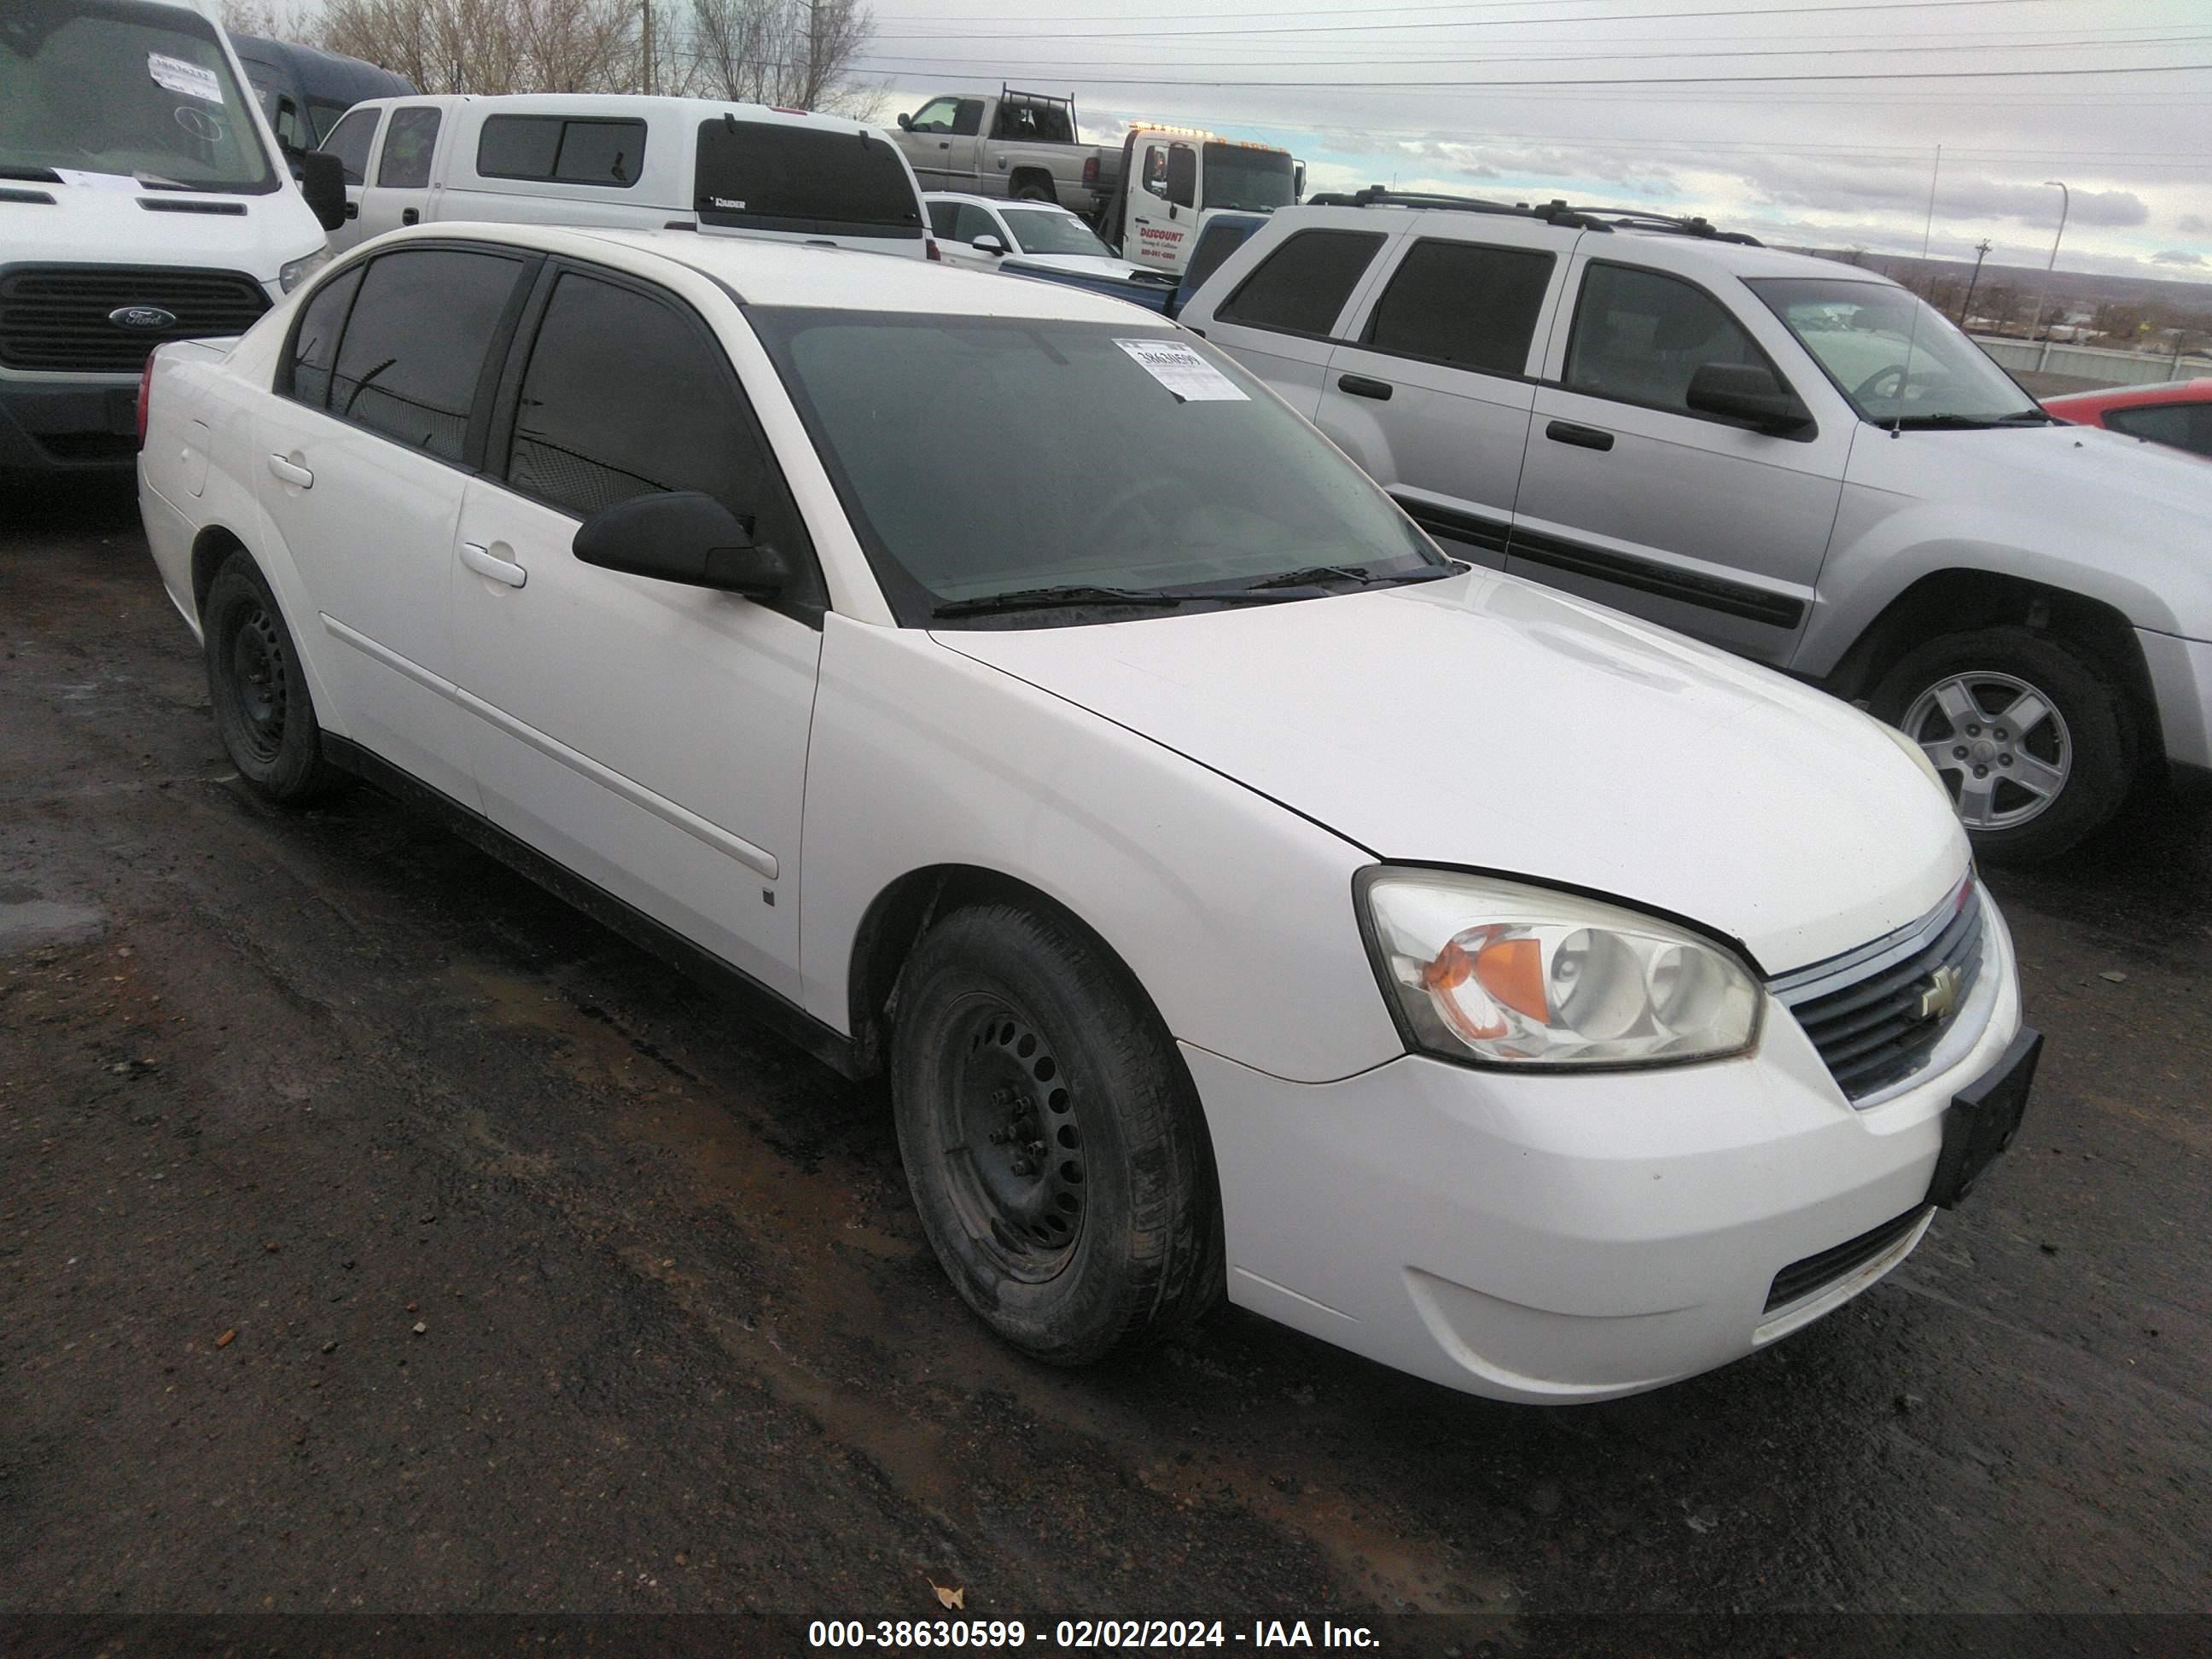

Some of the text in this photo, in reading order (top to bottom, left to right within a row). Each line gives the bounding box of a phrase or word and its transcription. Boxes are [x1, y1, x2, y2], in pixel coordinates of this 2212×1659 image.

[1139, 227, 1185, 242] DISCOUNT
[125, 310, 162, 325] Ford
[1138, 352, 1201, 365] 38630599
